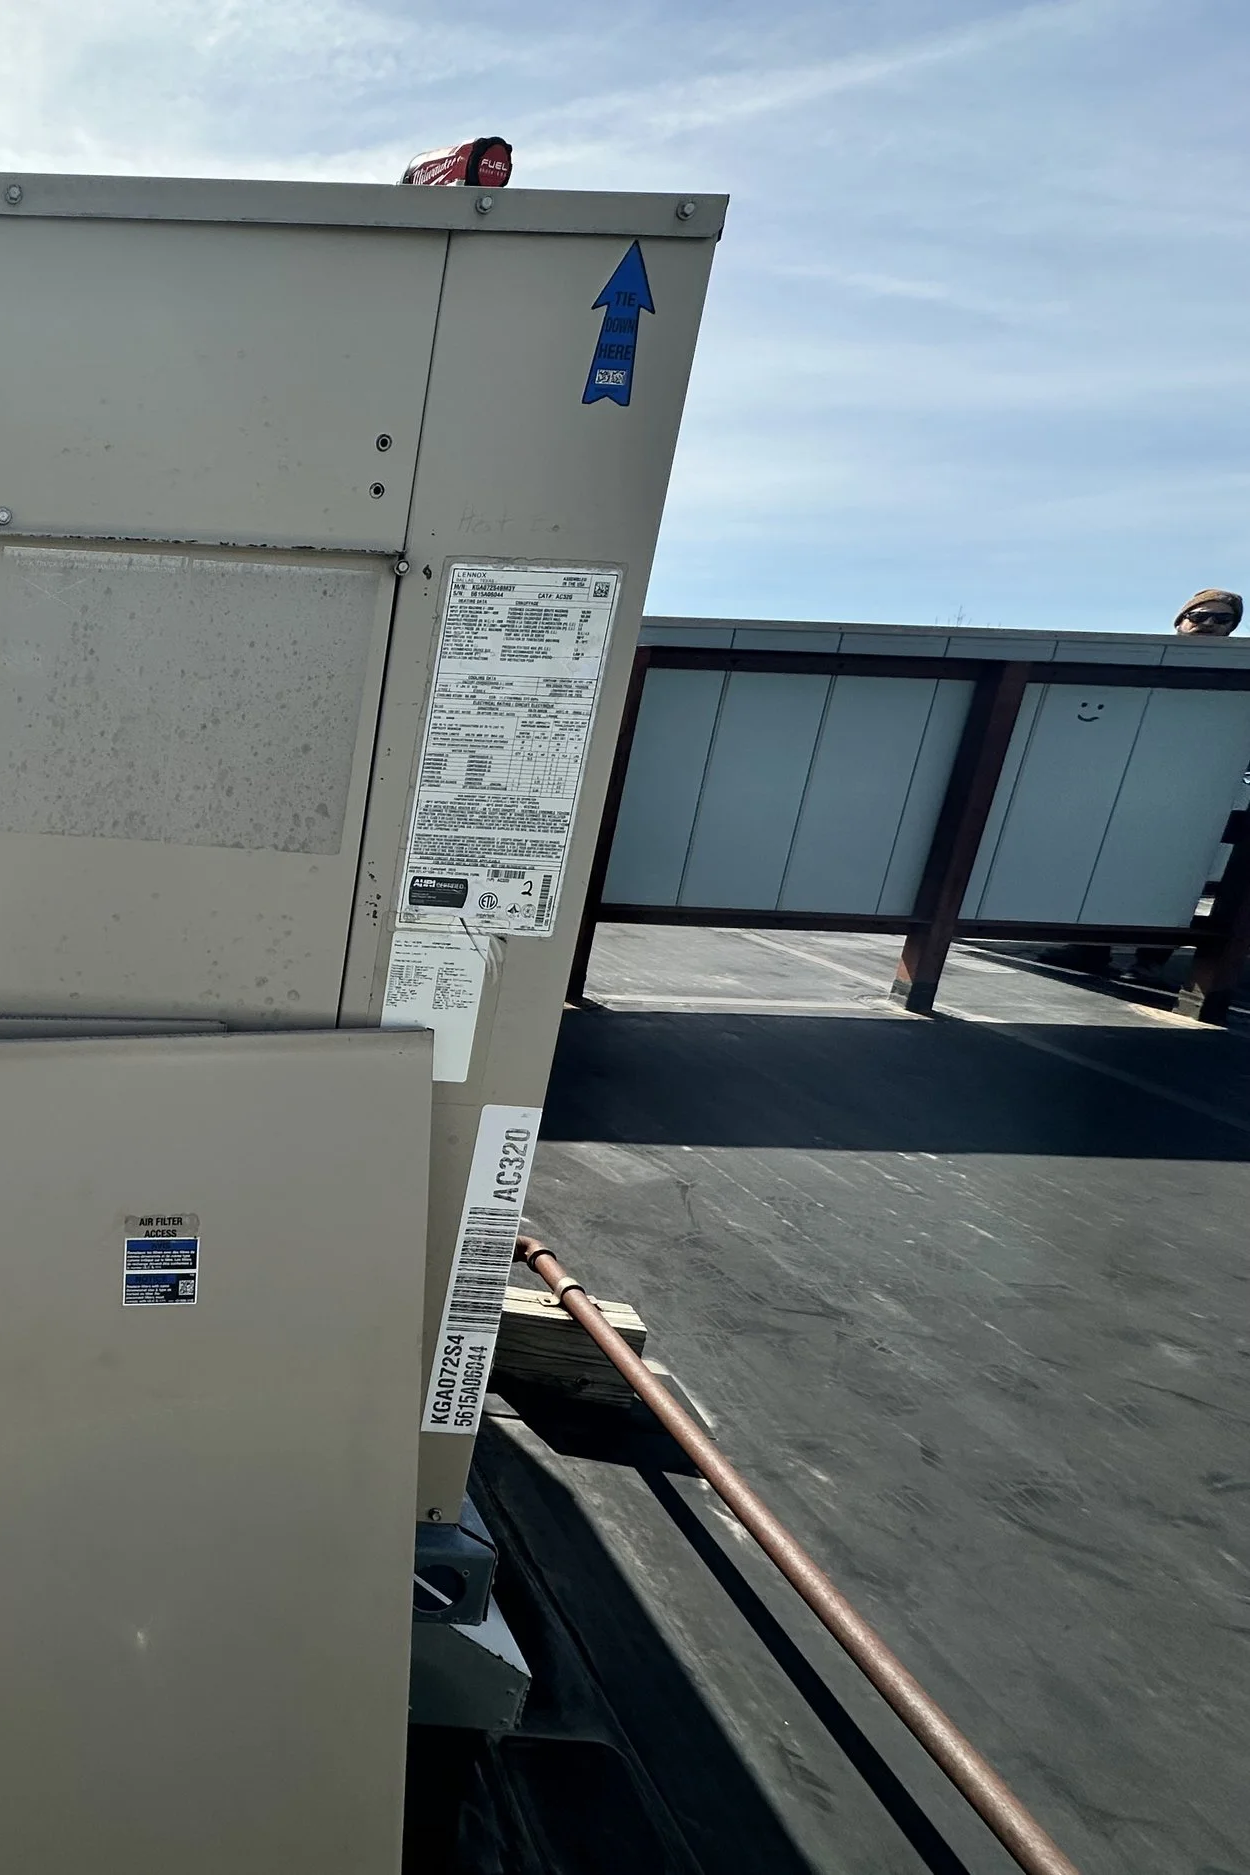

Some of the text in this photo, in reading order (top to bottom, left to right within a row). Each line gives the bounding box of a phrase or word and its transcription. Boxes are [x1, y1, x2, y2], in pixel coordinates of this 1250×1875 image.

[481, 158, 508, 171] FUEL
[615, 292, 636, 307] TIE
[605, 318, 634, 334] DOWN
[598, 344, 633, 360] HERE
[521, 880, 534, 896] 2
[492, 1127, 532, 1202] AC320
[139, 1217, 183, 1226] AIR FILTER
[430, 1334, 465, 1424] KGA072S4
[454, 1344, 488, 1427] 5615A06044
